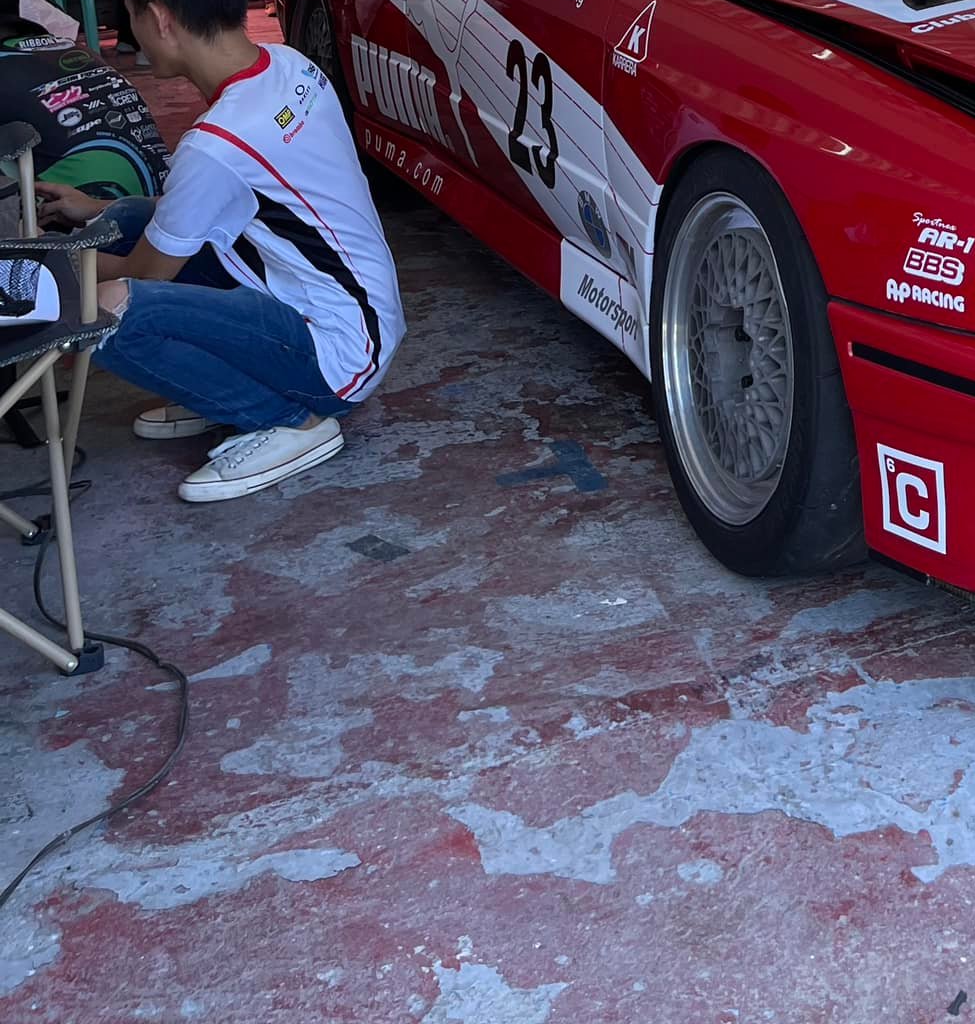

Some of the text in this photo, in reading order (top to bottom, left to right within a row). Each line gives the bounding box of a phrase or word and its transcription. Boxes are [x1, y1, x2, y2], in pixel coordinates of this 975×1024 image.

[628, 24, 643, 53] K
[351, 33, 448, 147] PUMA
[506, 39, 559, 189] 23
[365, 128, 443, 195] puma.com
[918, 227, 975, 254] AR-1
[903, 247, 965, 286] BBS
[886, 278, 965, 313] AP RACING
[887, 457, 896, 473] 6
[896, 472, 930, 530] C
